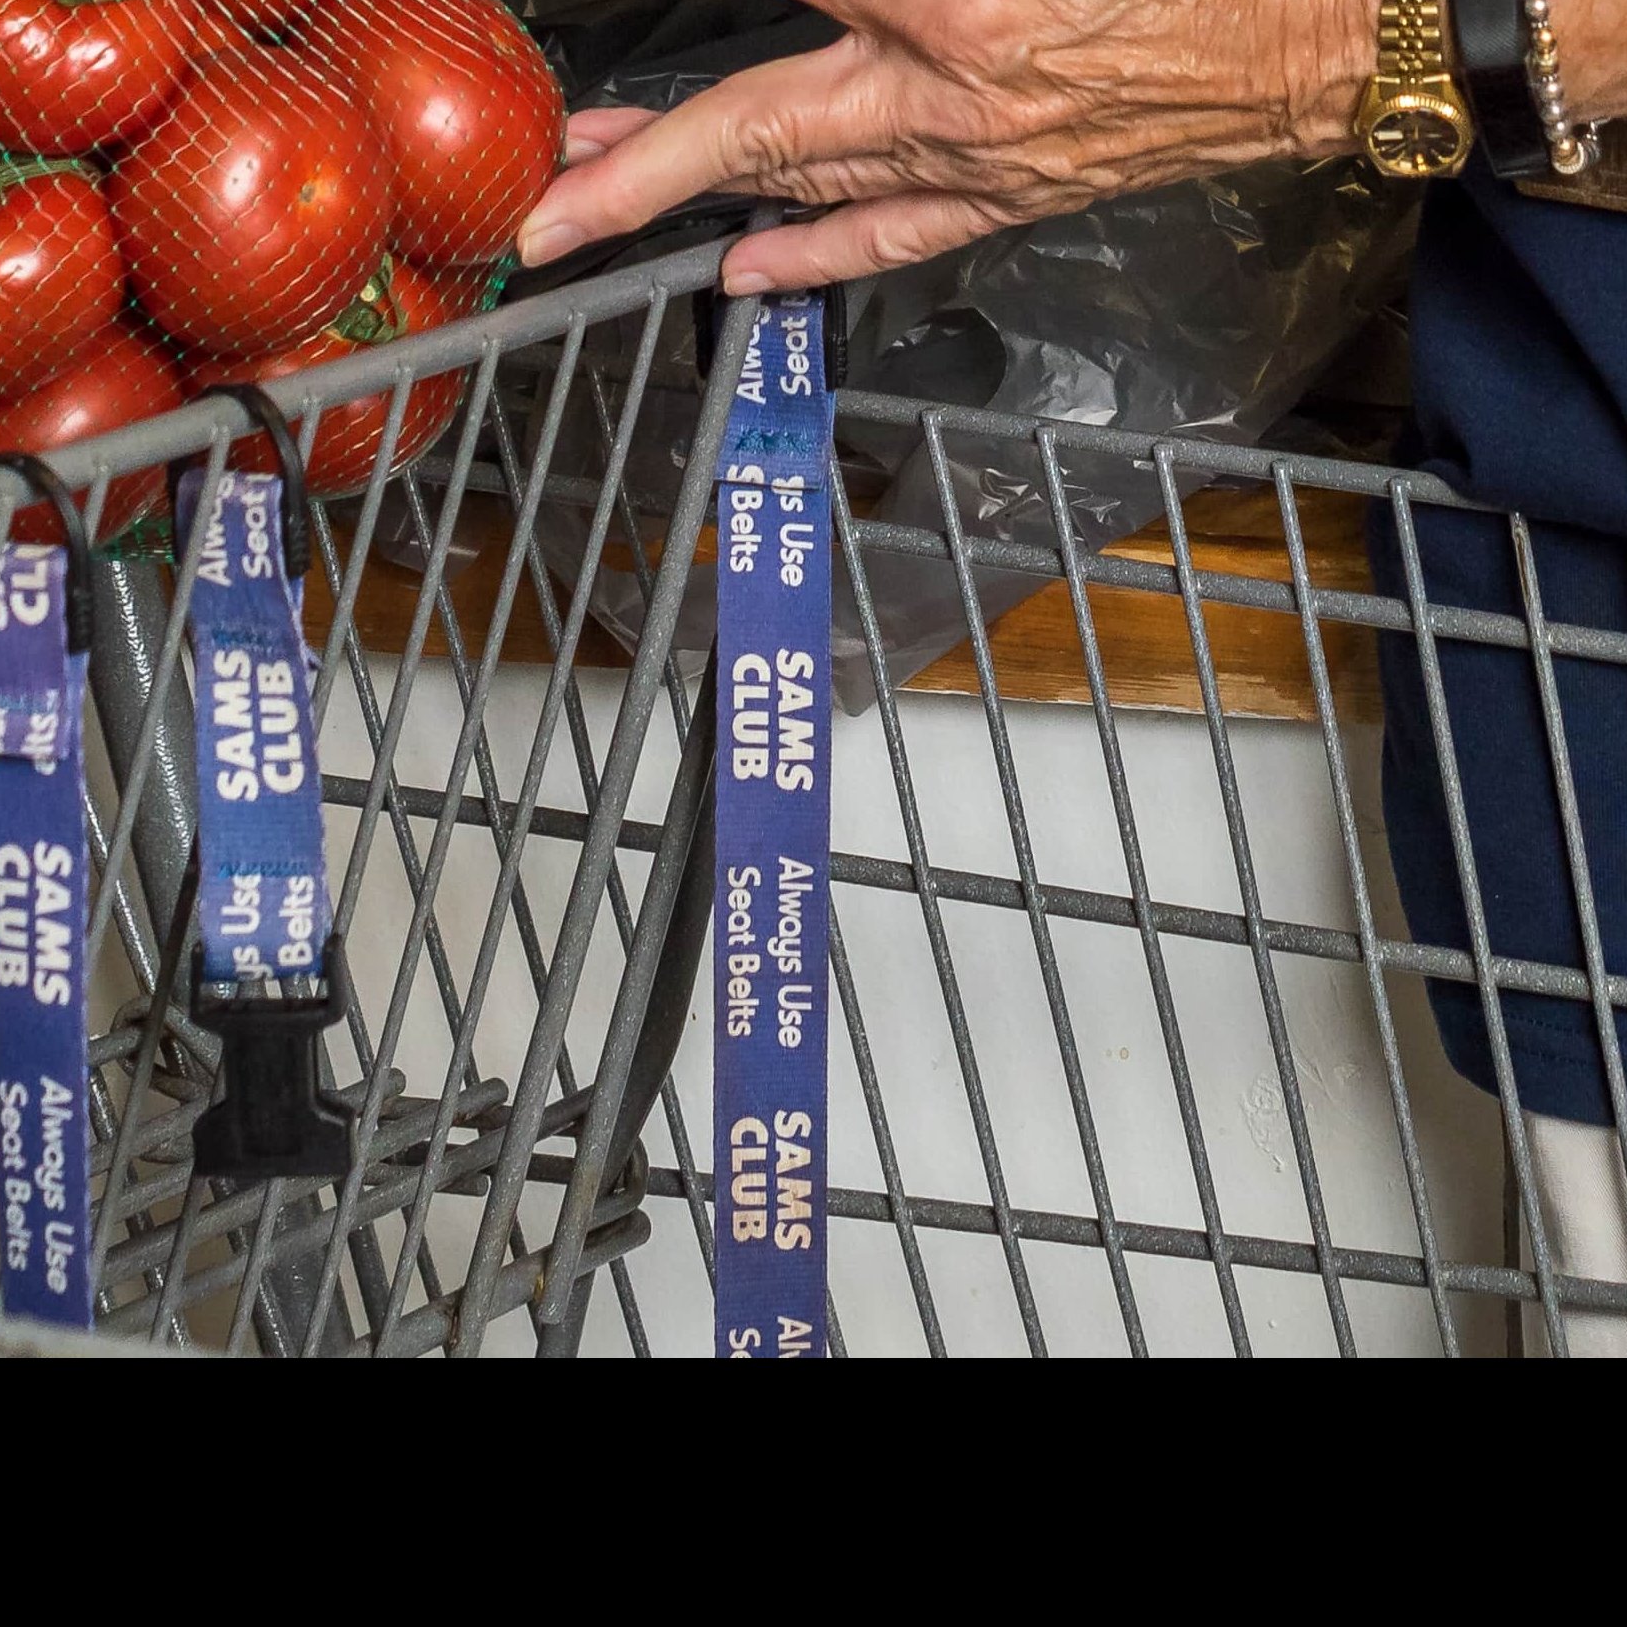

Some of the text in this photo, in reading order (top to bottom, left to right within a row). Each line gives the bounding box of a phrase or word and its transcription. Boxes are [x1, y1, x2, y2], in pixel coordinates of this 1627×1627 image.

[779, 315, 813, 397] Seat
[240, 488, 274, 581] Seat
[729, 489, 764, 574] Belts
[779, 522, 815, 588] Use
[212, 648, 260, 803] SAMS
[256, 658, 305, 794] CLUB
[731, 652, 772, 782] CLUB
[775, 648, 815, 793] SAMS
[33, 839, 73, 1008] SAMS
[276, 874, 315, 968] Belts
[727, 865, 762, 1039] Seat Belts
[766, 856, 814, 1050] Always Use
[3, 1177, 33, 1272] Belts
[33, 1074, 75, 1295] Always Use
[729, 1116, 770, 1243] CLUB
[773, 1109, 813, 1251] SAMS
